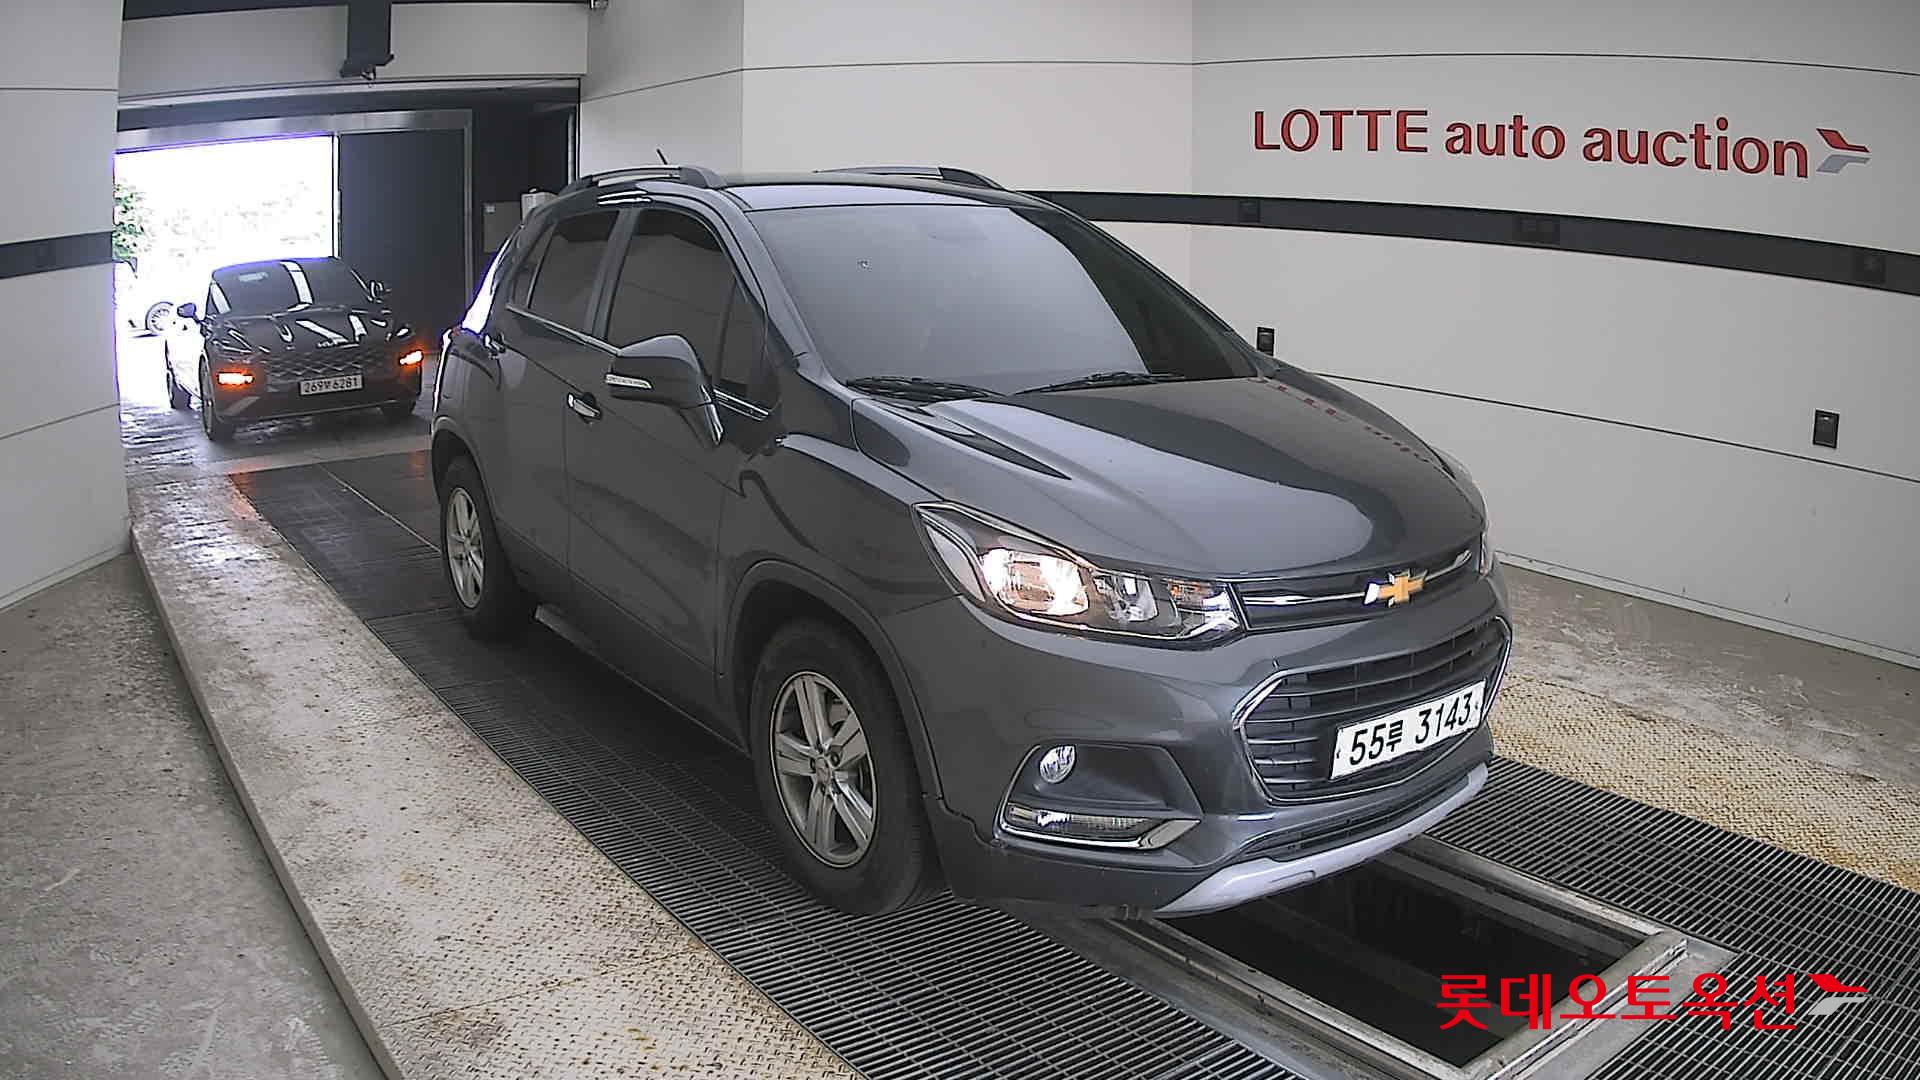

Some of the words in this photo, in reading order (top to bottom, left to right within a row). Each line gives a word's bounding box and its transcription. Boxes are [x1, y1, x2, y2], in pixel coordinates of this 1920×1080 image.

[1254, 108, 1428, 152] LOTTE
[1444, 114, 1566, 160] auto
[1582, 116, 1808, 178] auction
[332, 377, 358, 389] 6281
[1350, 719, 1403, 765] 55루
[1415, 691, 1473, 744] 3143
